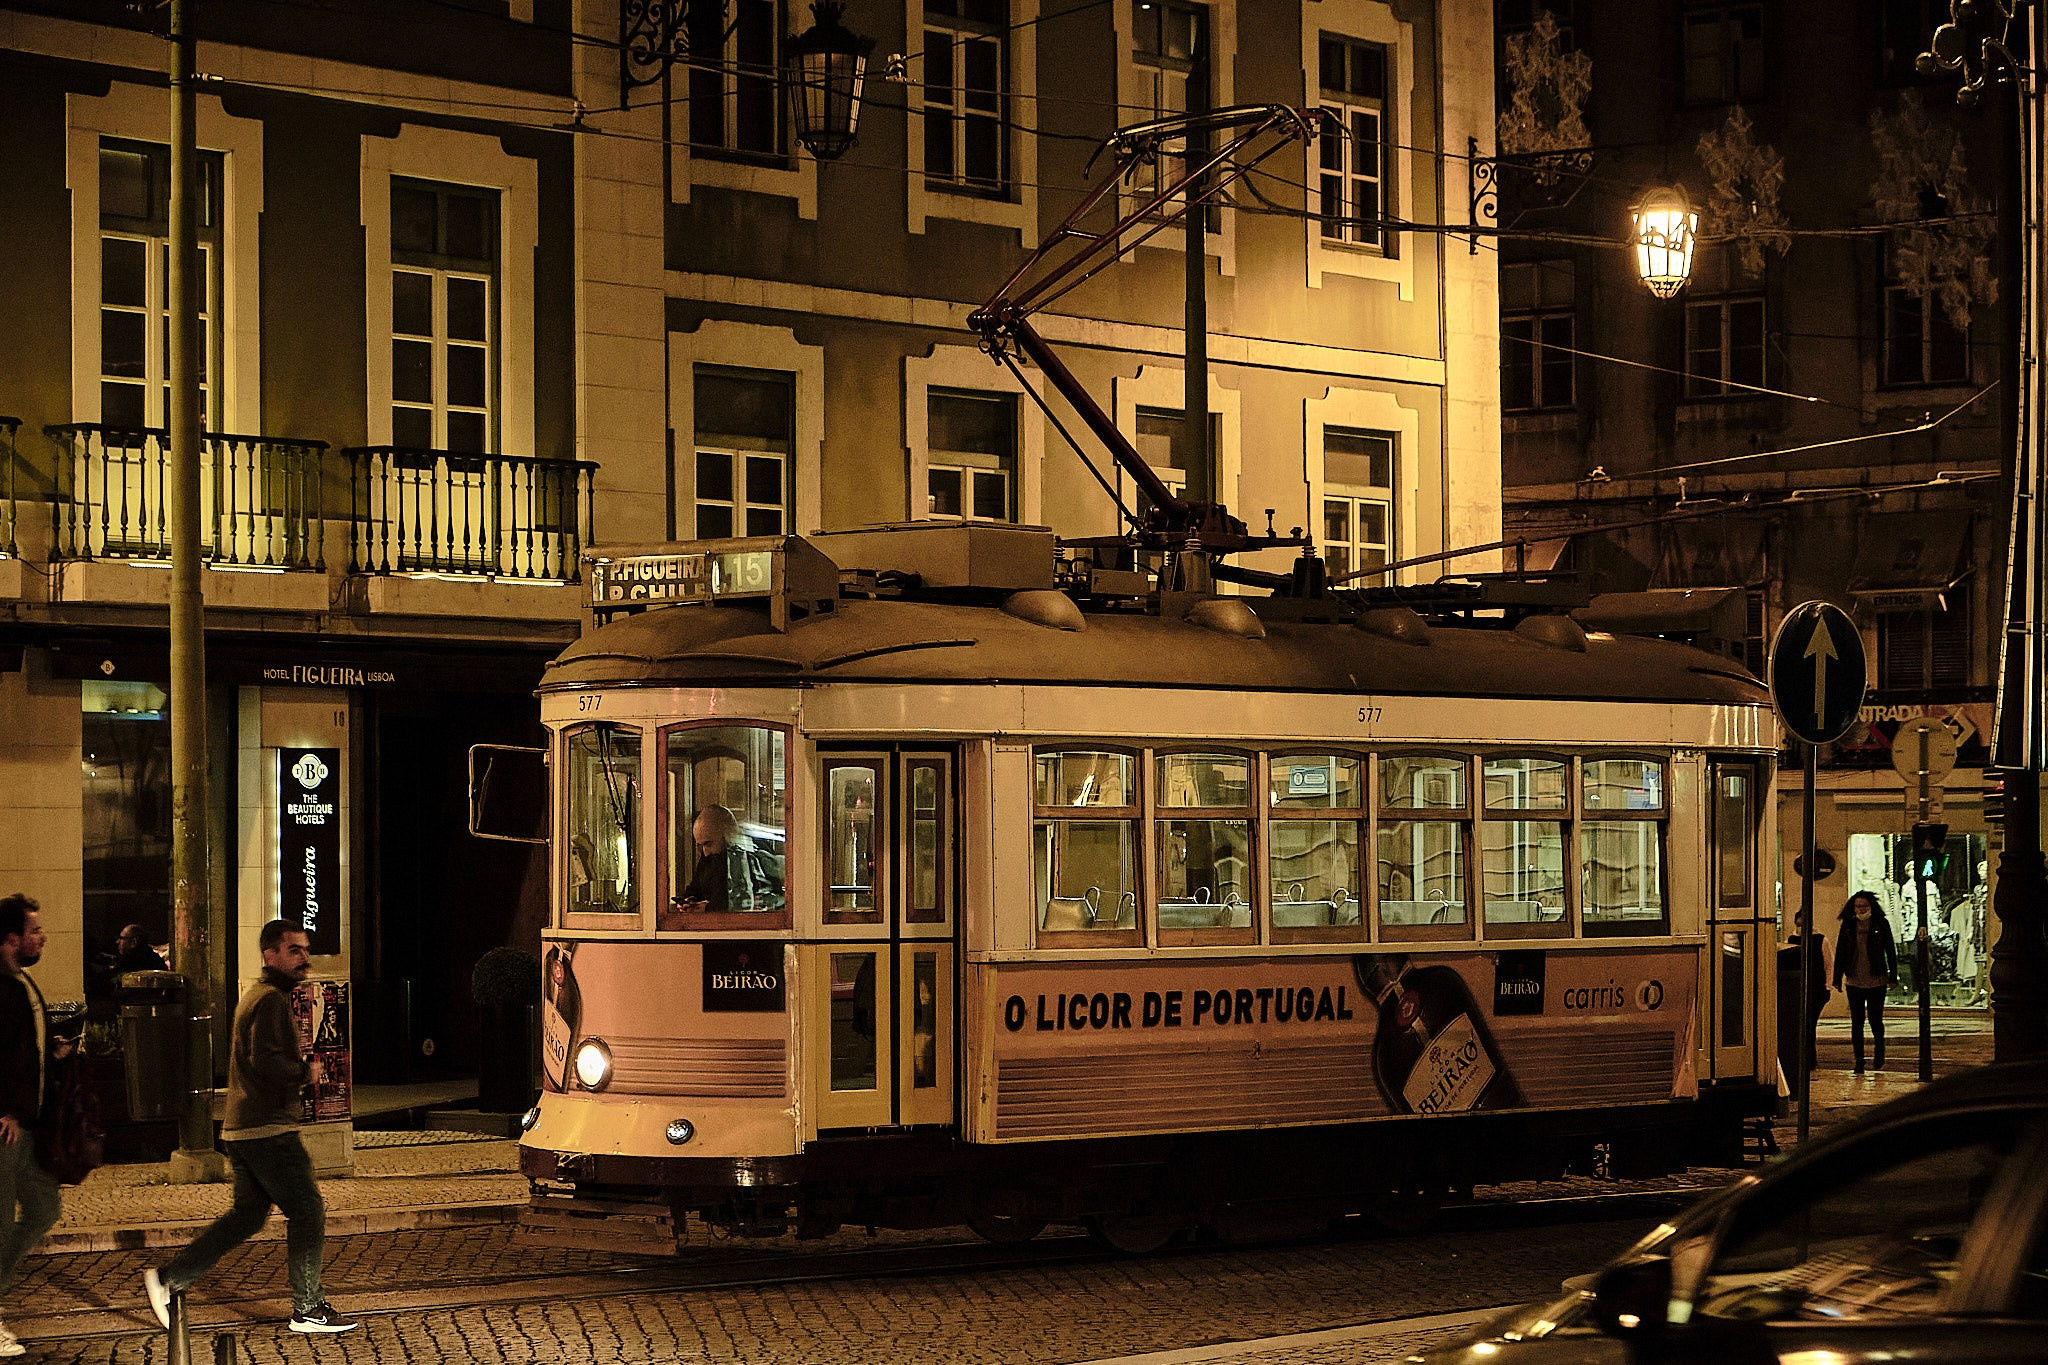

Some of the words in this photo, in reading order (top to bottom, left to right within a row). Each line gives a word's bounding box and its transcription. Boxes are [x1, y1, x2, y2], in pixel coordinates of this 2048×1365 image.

[733, 553, 763, 588] 15
[263, 669, 290, 679] HOTEL
[293, 665, 365, 686] FIGUEIRA
[367, 671, 395, 682] LISBOA
[579, 695, 602, 711] 577
[1358, 707, 1382, 722] 577
[305, 764, 316, 780] B
[303, 794, 318, 804] THE
[287, 804, 334, 815] BEAUTIQUE
[296, 815, 325, 825] HOTELS
[303, 846, 319, 932] Figueira
[712, 973, 777, 990] BEIRÃO
[1500, 980, 1541, 996] BEIRÃO
[1563, 979, 1625, 1010] carris
[1005, 994, 1027, 1032] O
[1037, 992, 1132, 1031] LICOR
[1142, 991, 1183, 1027] DE
[1193, 985, 1353, 1027] PORTUGAL
[1418, 1041, 1479, 1114] BEIRÃO
